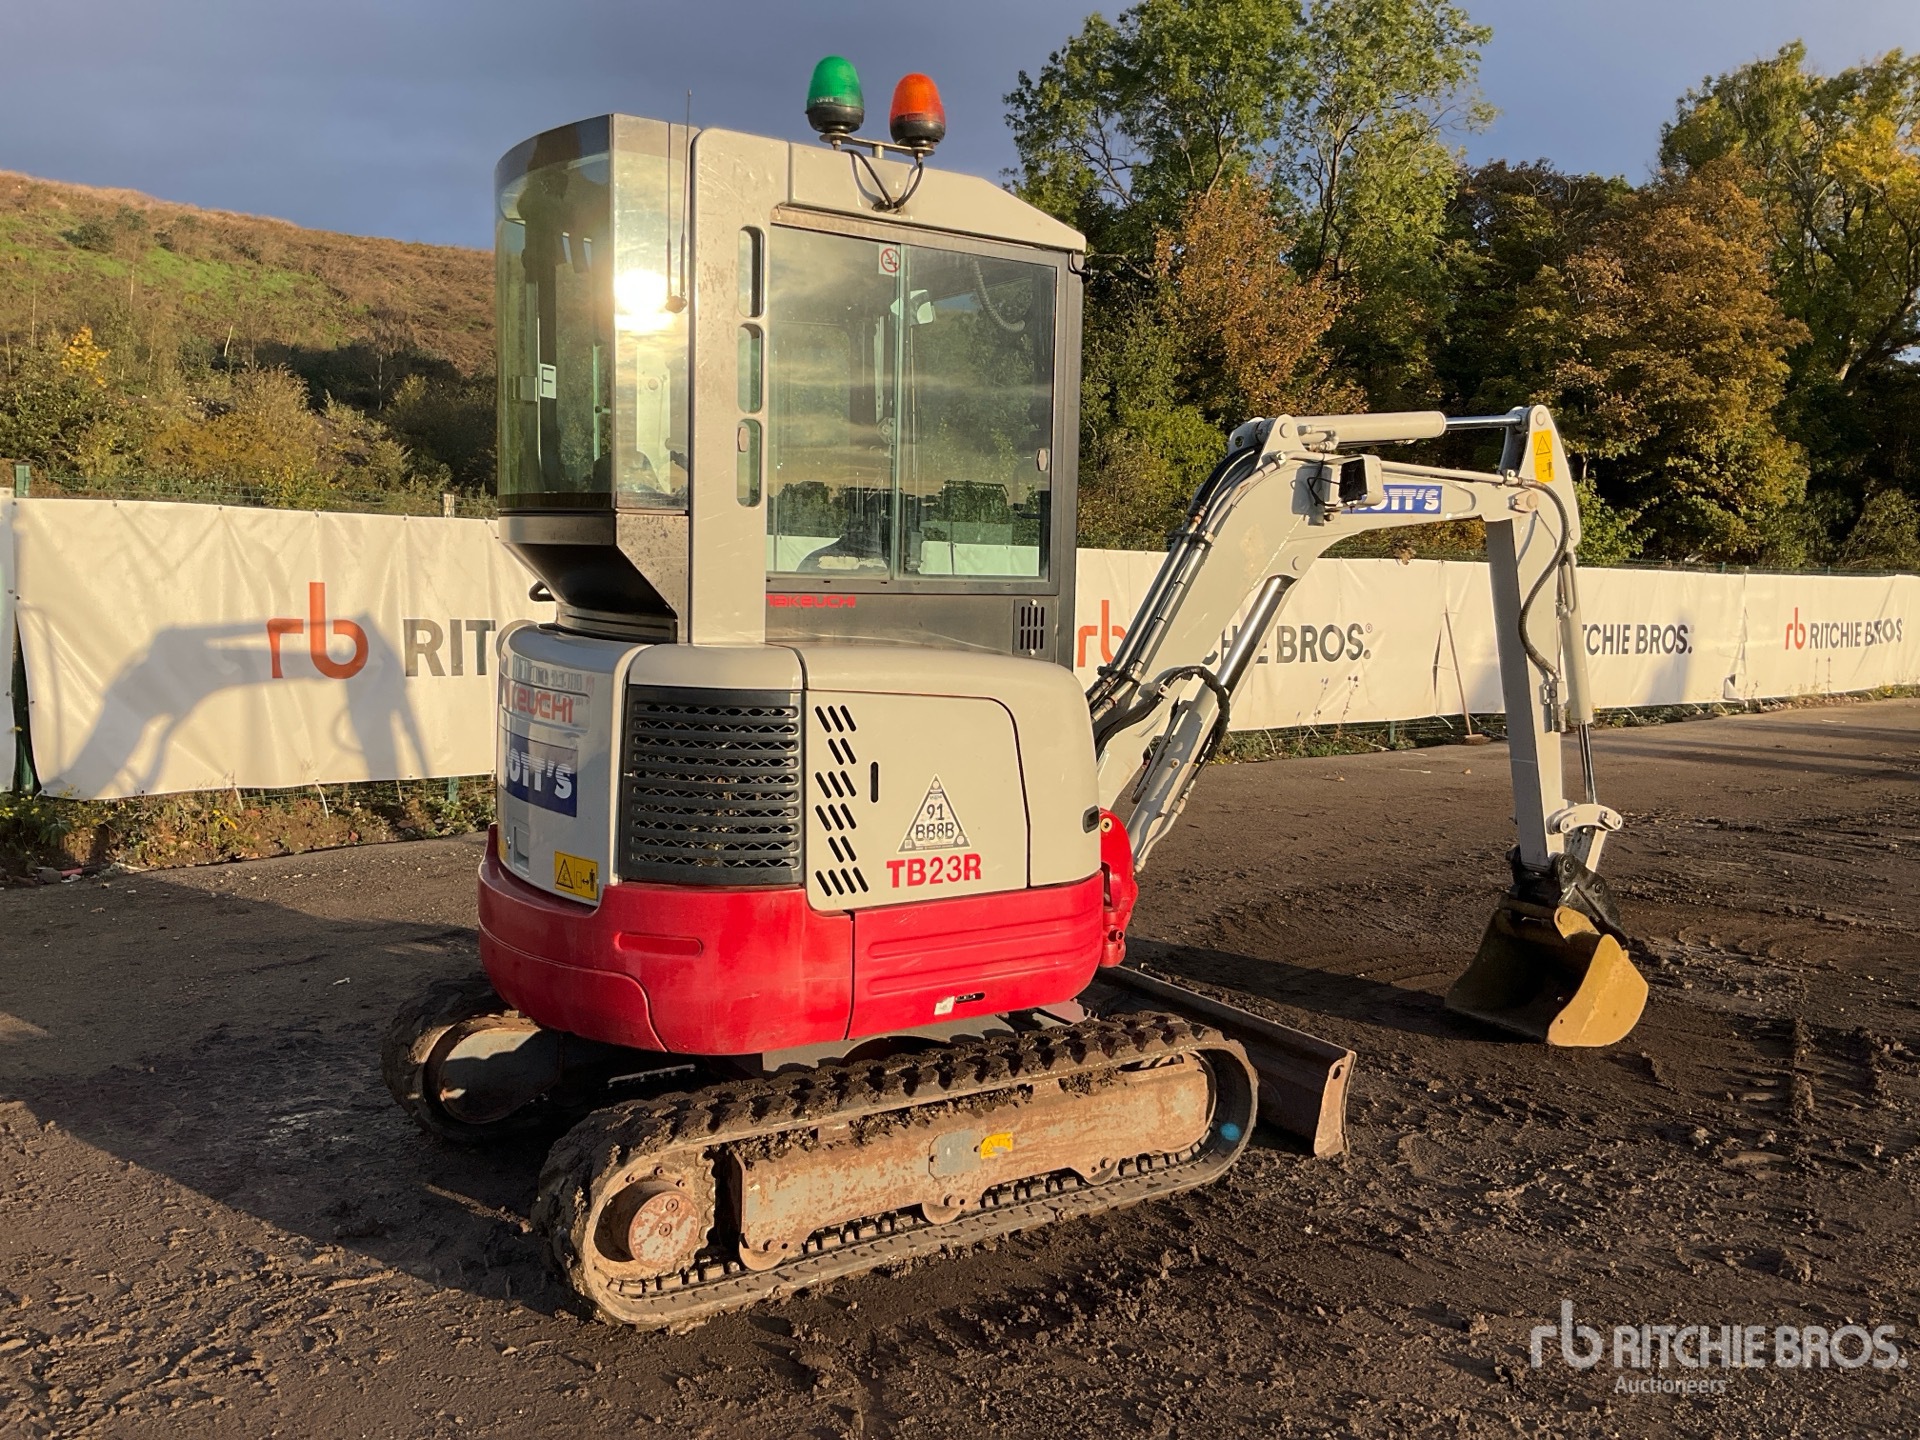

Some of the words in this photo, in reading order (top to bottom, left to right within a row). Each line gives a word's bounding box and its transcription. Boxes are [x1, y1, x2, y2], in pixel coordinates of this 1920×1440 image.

[1370, 487, 1439, 511] OTT'S
[1809, 622, 1862, 650] RITCHIE
[926, 803, 945, 821] 91
[886, 853, 982, 888] TB23R
